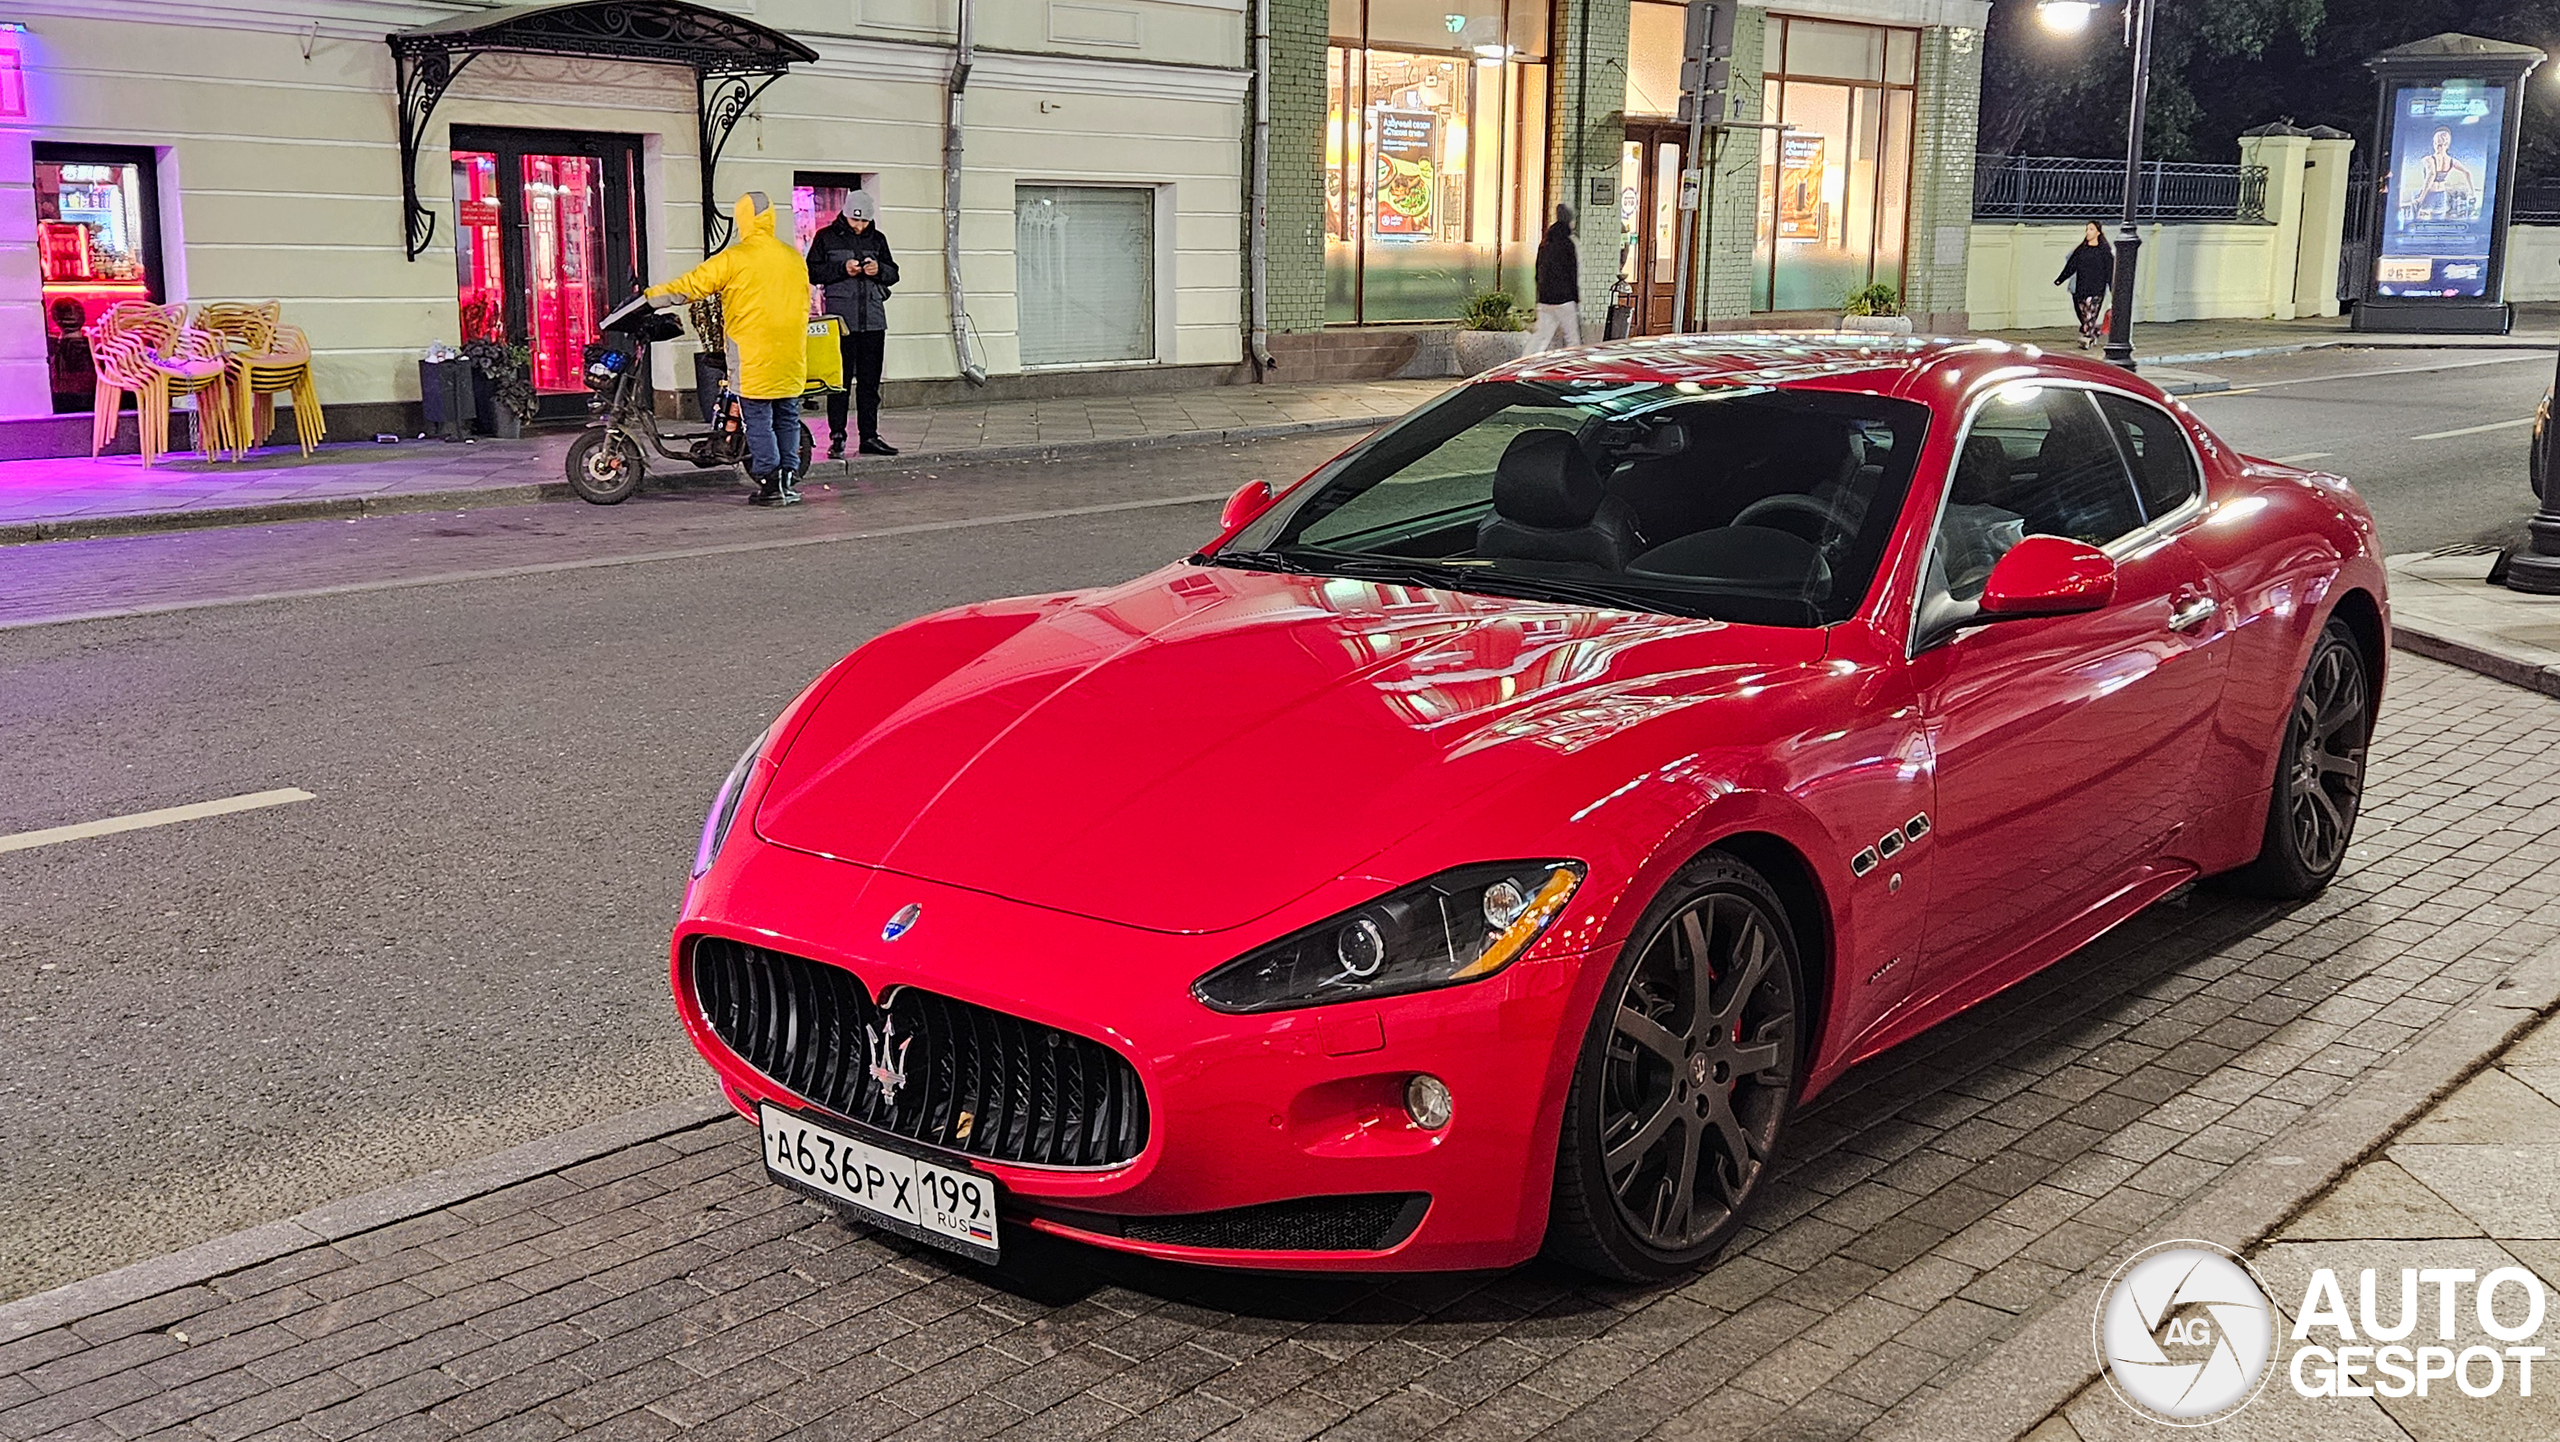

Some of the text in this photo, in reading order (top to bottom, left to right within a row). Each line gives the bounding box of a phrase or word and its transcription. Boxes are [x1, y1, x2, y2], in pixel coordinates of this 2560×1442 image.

[807, 324, 827, 334] 565
[922, 1171, 981, 1220] 199
[937, 1211, 968, 1233] RUS
